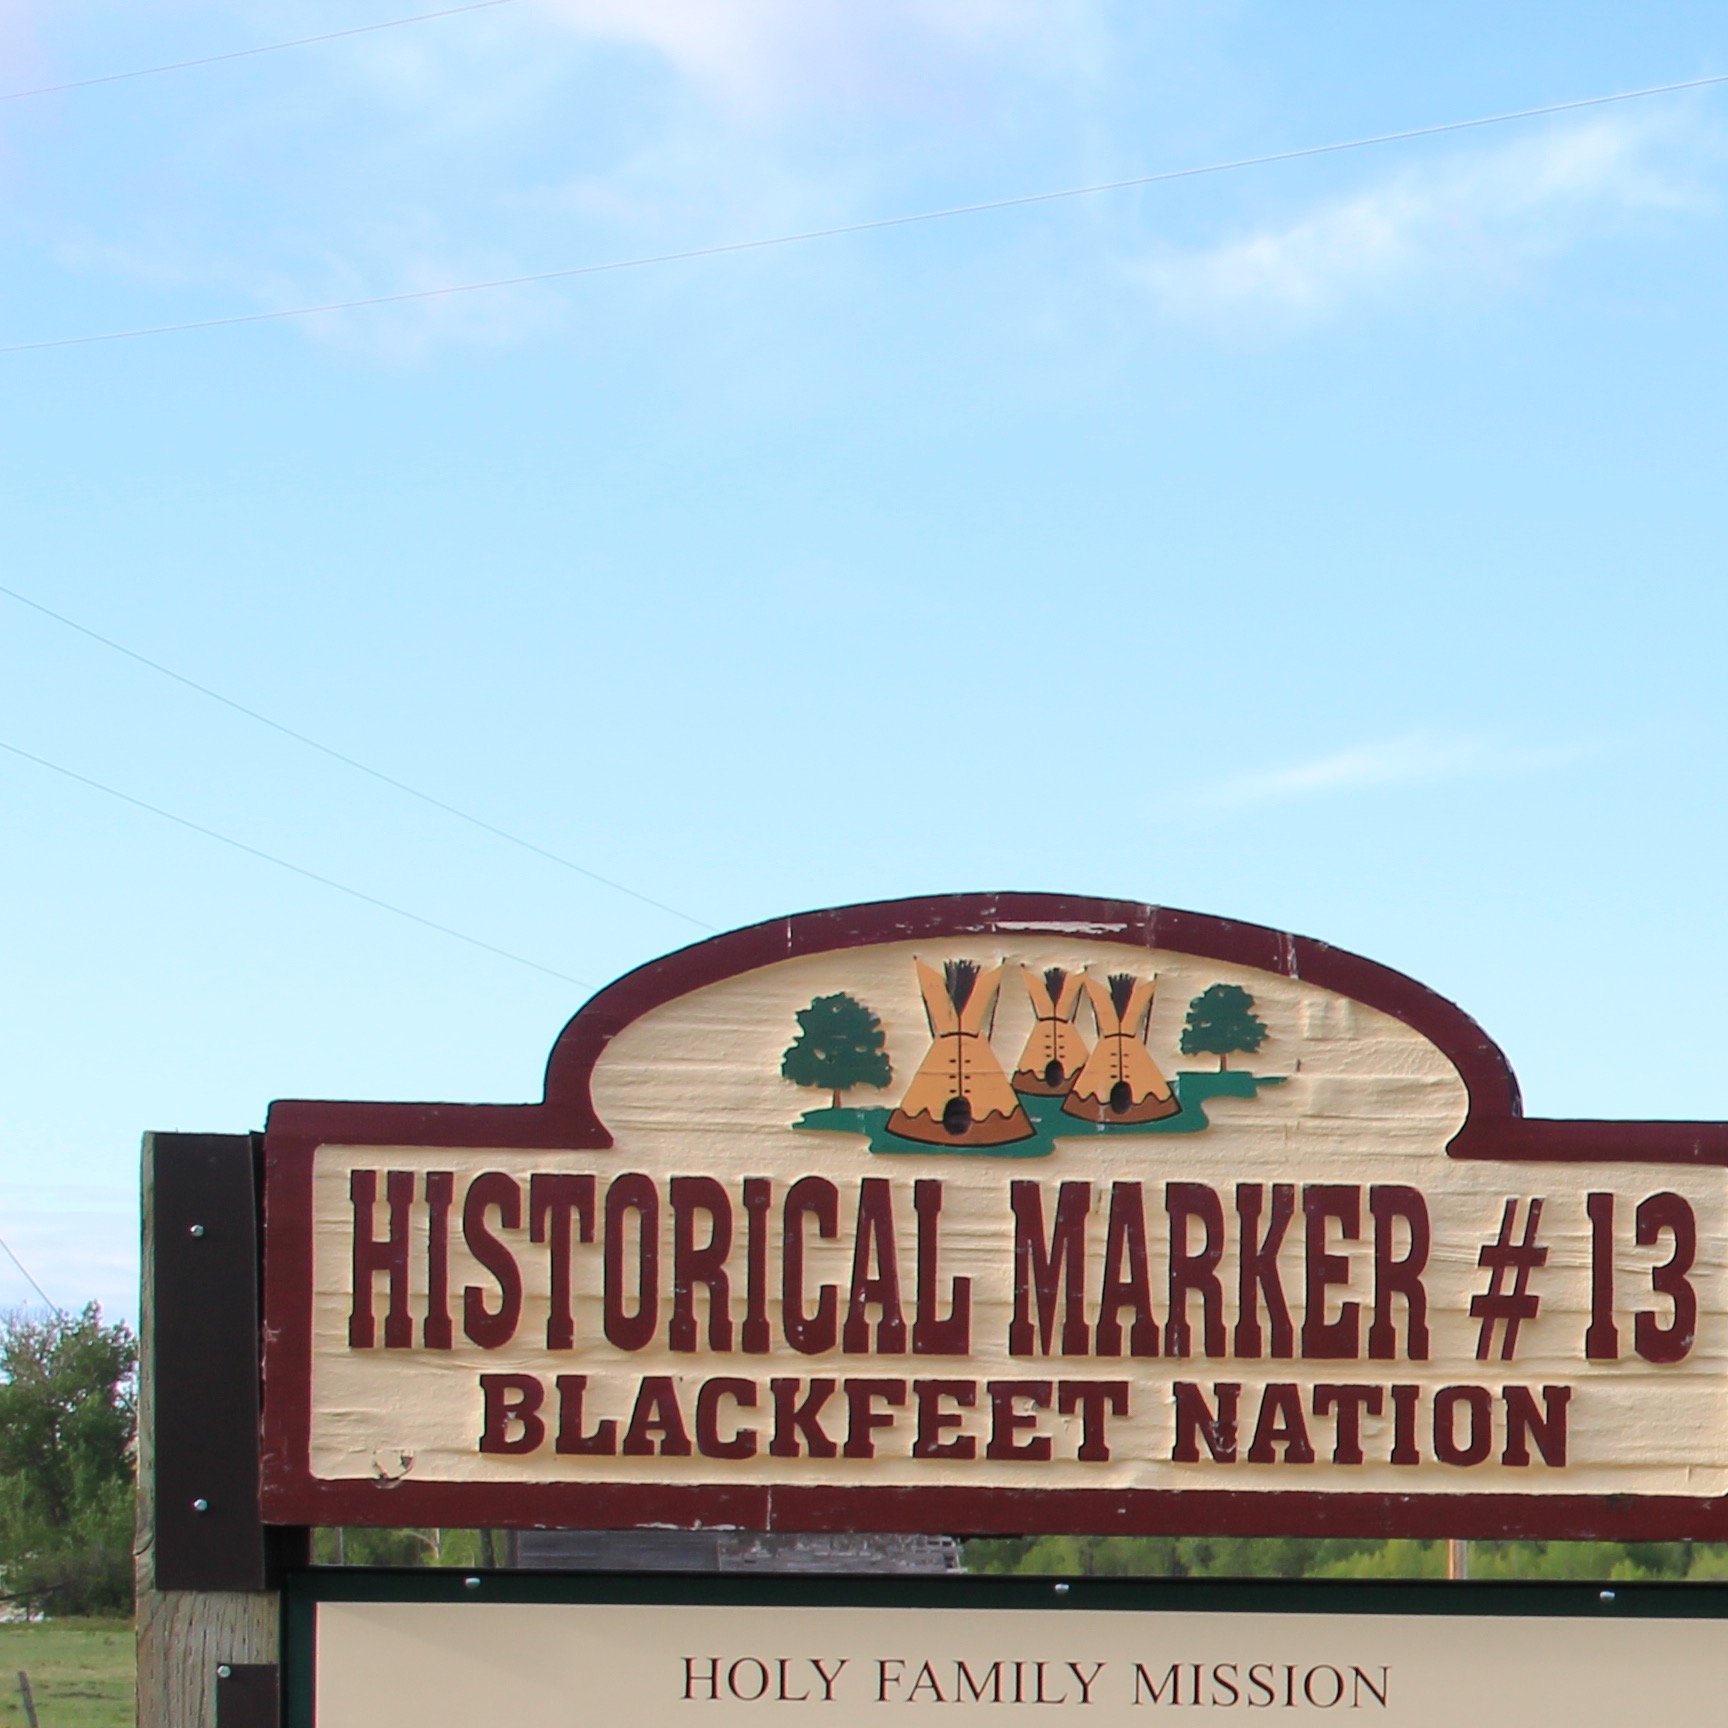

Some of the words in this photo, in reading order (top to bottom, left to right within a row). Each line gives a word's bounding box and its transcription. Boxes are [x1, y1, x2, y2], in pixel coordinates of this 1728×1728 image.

[349, 1170, 971, 1357] HISTORICAL
[1010, 1180, 1430, 1361] MARKER
[479, 1374, 1130, 1463] BLACKFEET
[1172, 1382, 1572, 1468] NATION
[680, 1657, 849, 1702] HOLY
[875, 1659, 1106, 1705] FAMILY
[1131, 1663, 1389, 1709] MISSION
